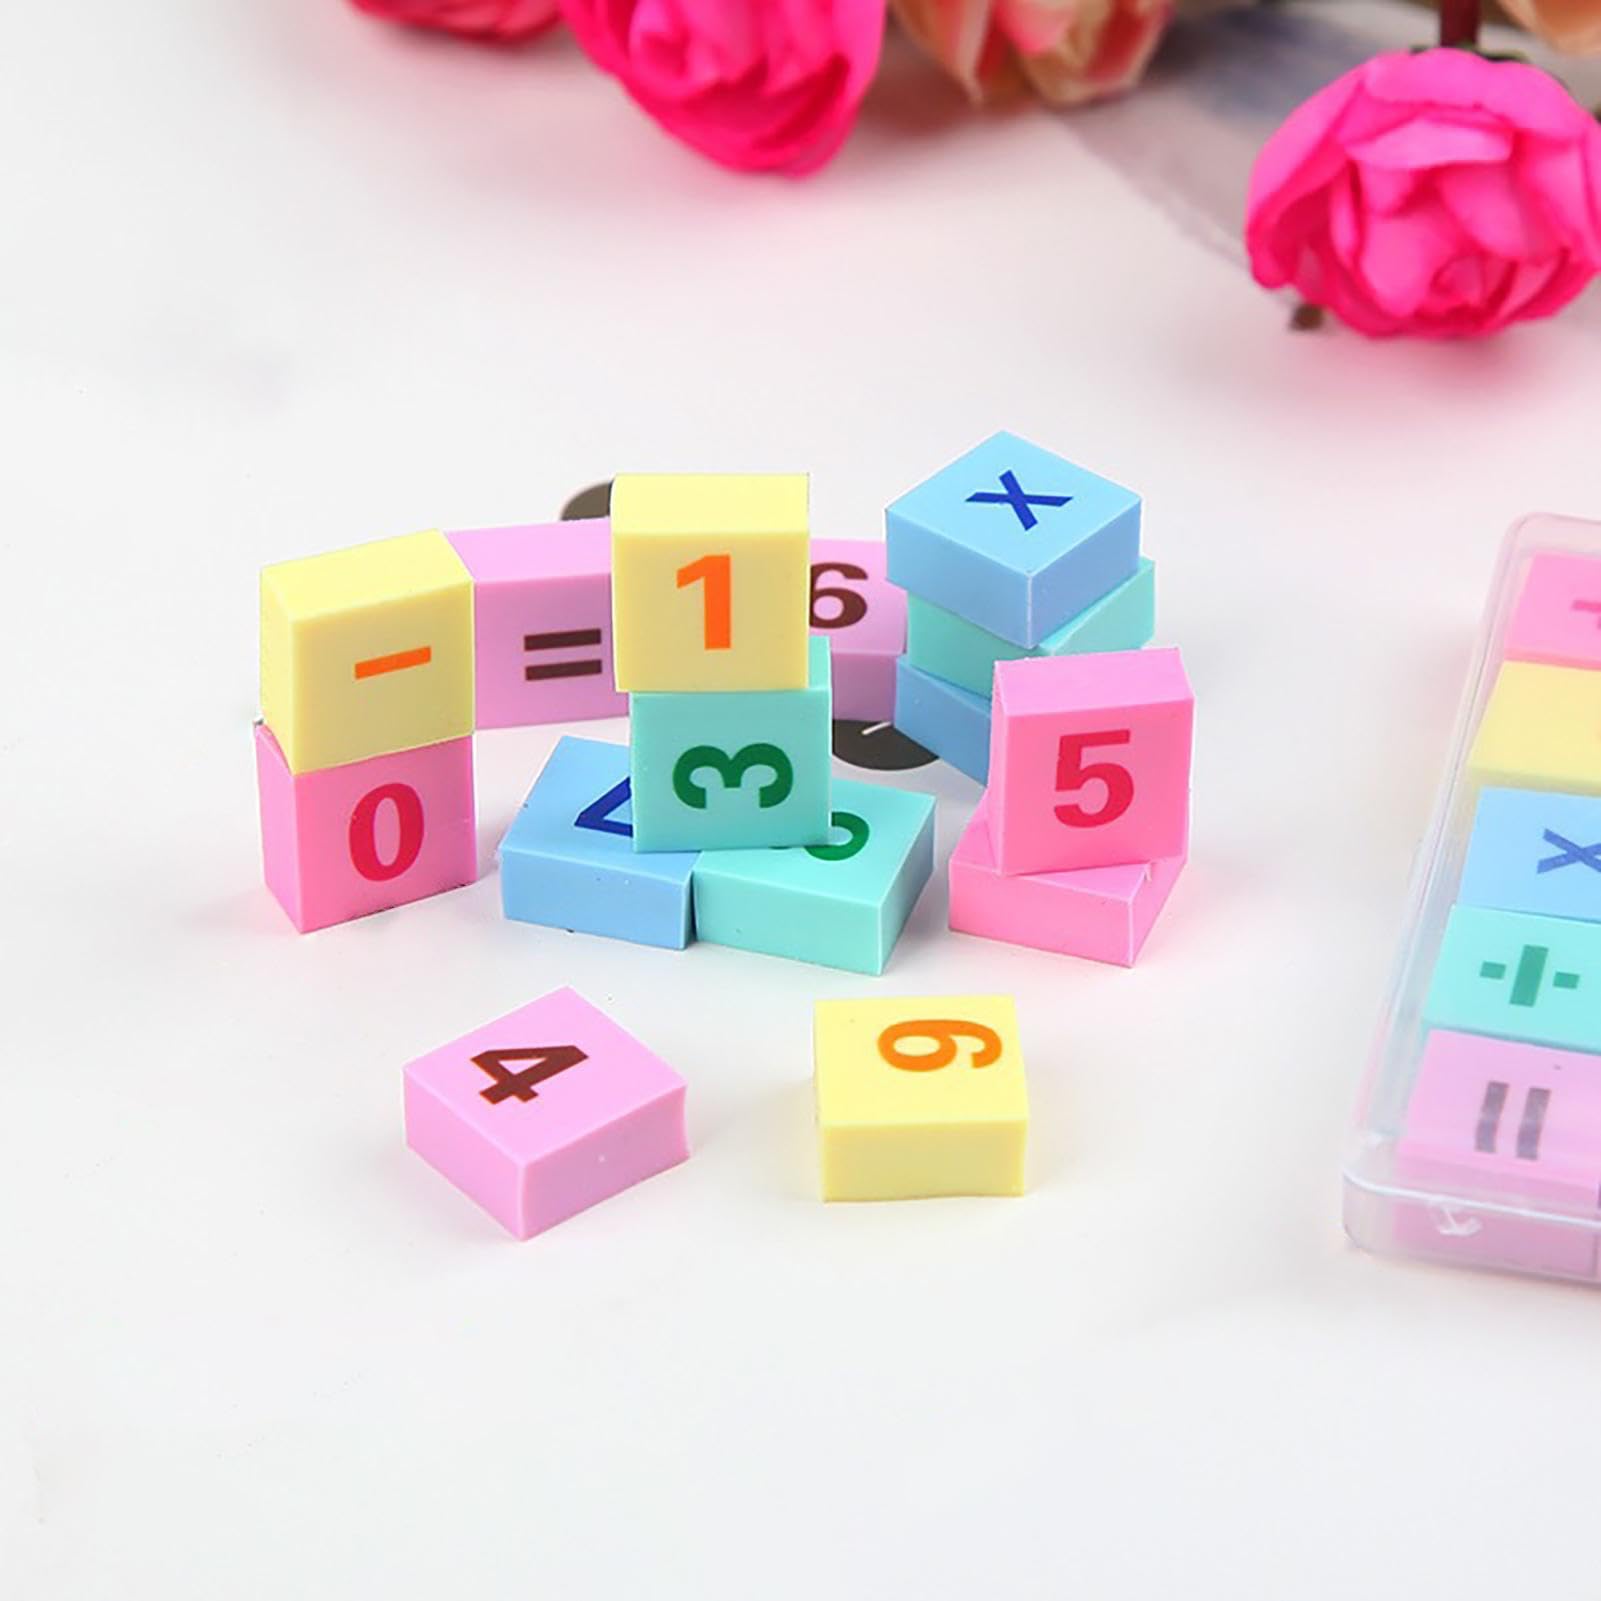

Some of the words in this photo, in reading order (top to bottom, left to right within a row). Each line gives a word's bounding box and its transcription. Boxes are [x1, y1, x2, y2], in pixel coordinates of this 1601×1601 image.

[676, 555, 734, 650] 1
[809, 562, 868, 629] 6
[673, 742, 794, 810] 3
[1053, 729, 1135, 828] 5
[348, 783, 425, 882] 0
[470, 1045, 589, 1105] 4
